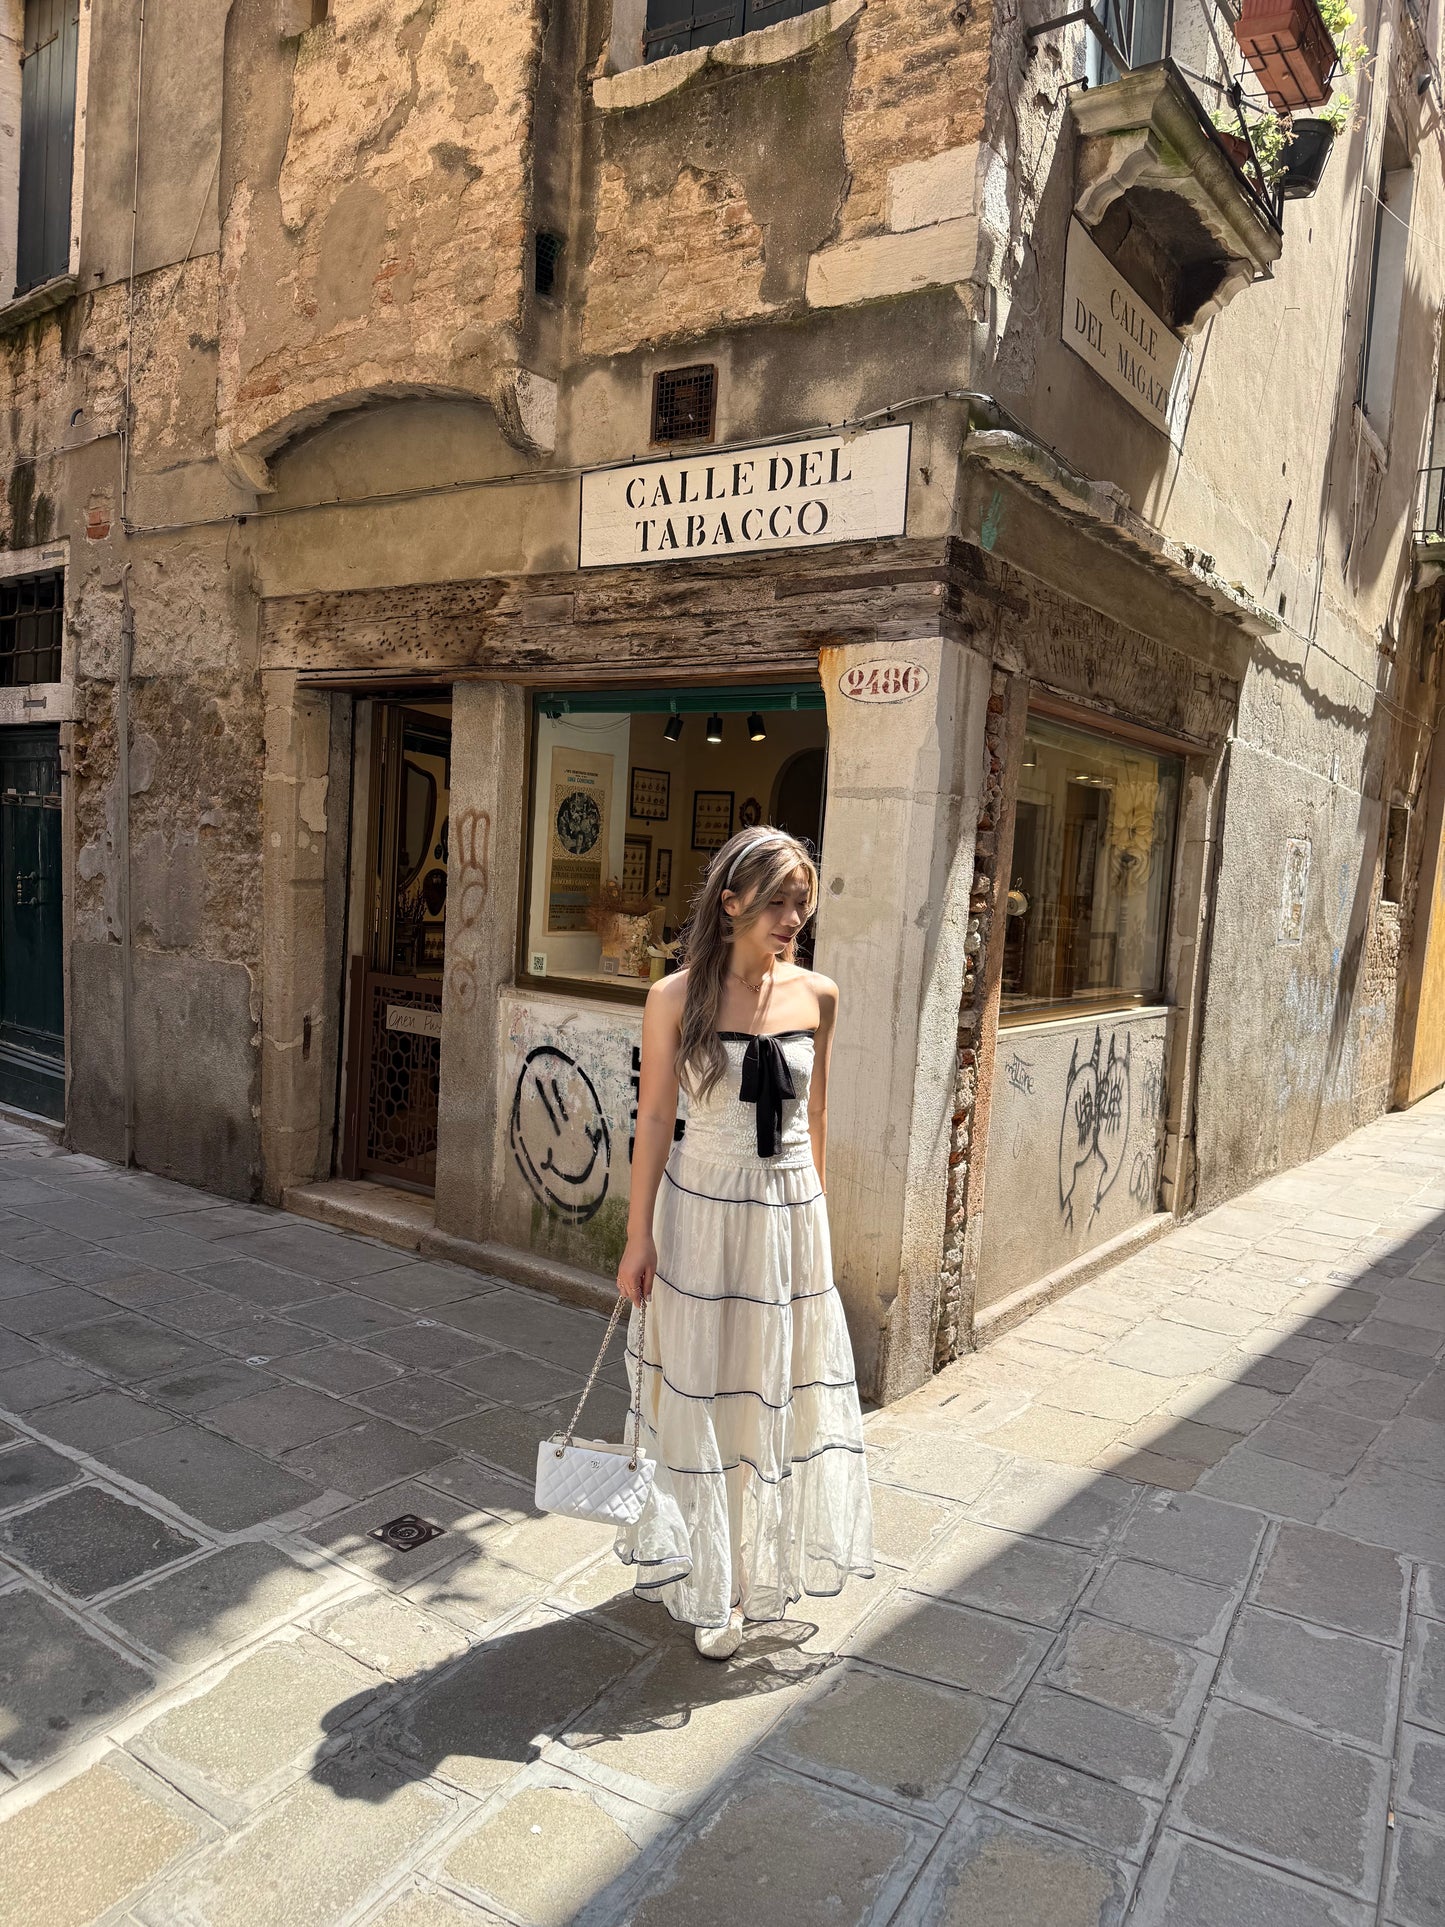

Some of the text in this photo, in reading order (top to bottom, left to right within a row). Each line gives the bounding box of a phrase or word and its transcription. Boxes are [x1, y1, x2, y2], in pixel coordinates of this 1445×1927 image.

[1074, 297, 1107, 358] DEL
[1110, 289, 1158, 361] CALLE
[625, 447, 852, 510] CALLE DEL
[635, 501, 829, 553] TABACCO
[848, 666, 921, 696] 2486
[389, 1010, 415, 1029] Open
